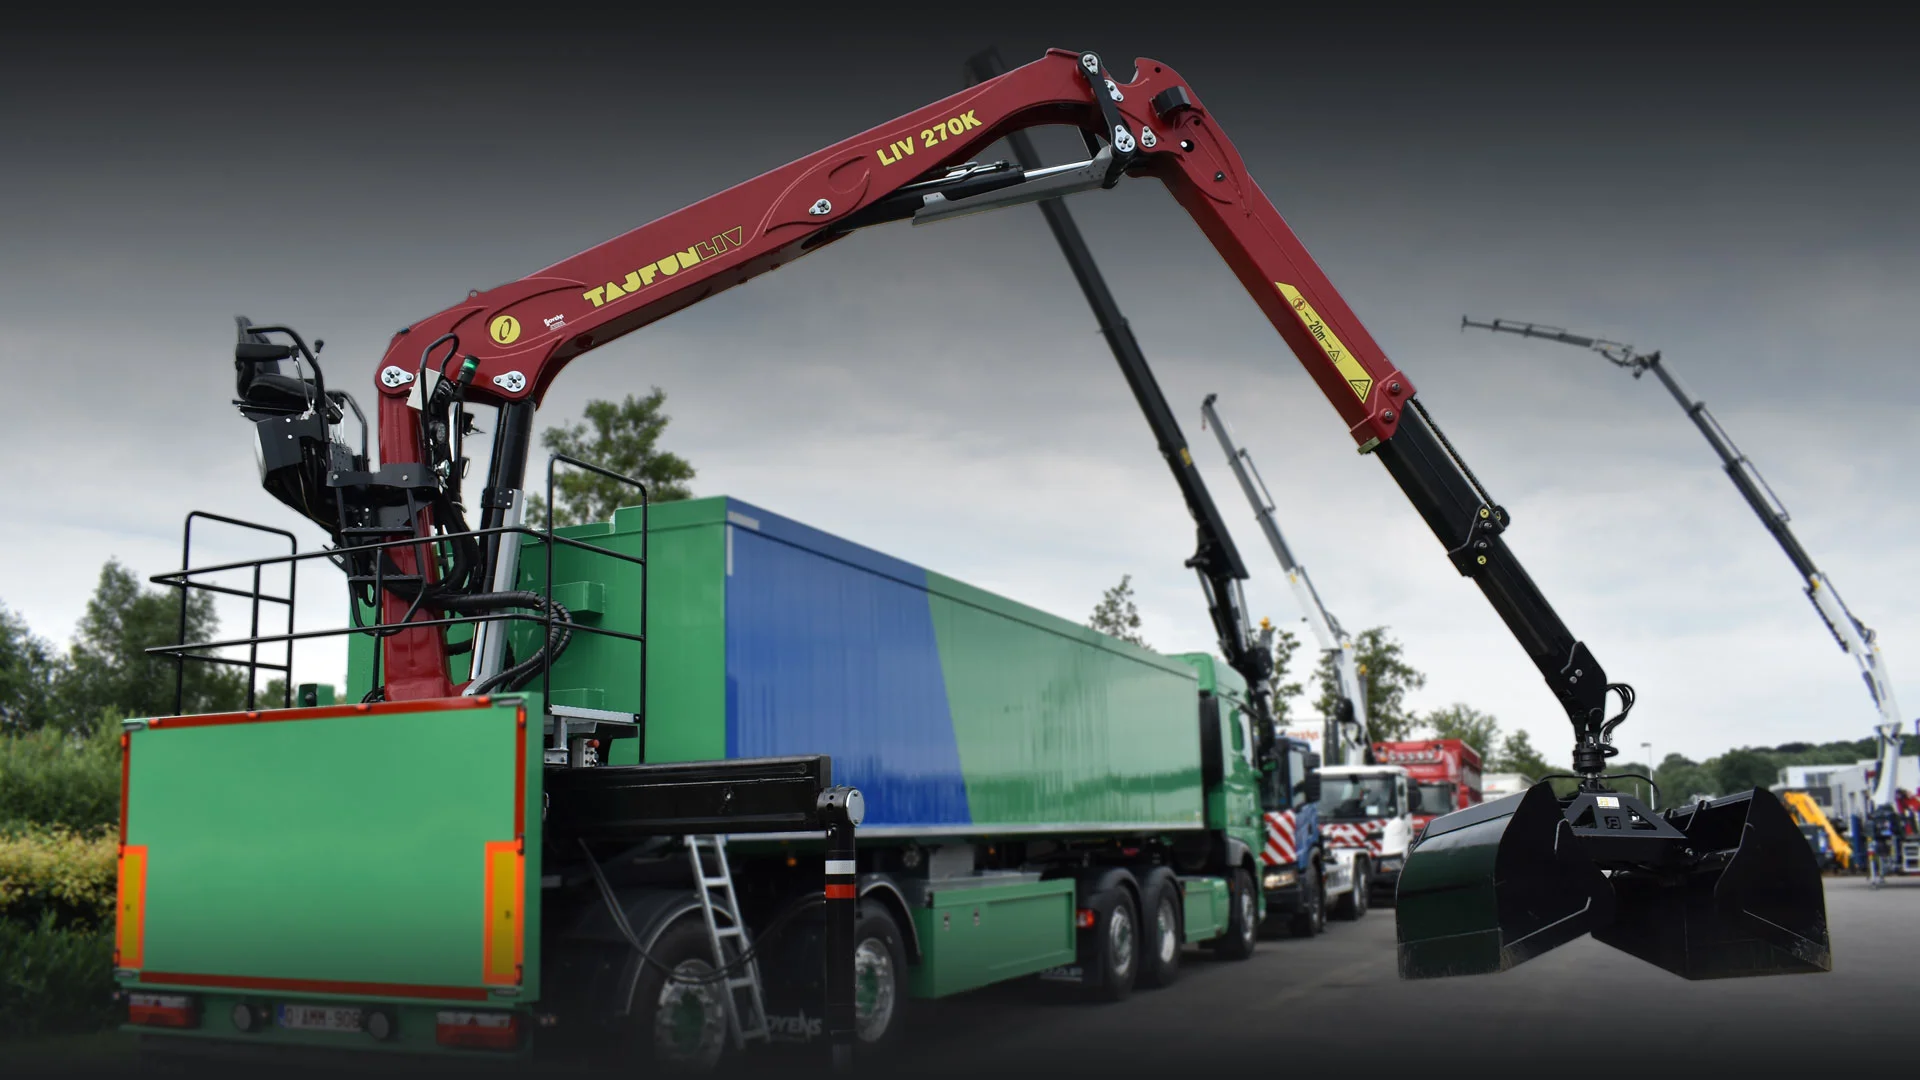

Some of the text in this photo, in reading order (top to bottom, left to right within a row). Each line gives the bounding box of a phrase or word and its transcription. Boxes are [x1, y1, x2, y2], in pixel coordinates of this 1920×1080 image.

[876, 109, 983, 167] LIV 270K
[1309, 321, 1326, 341] 20m
